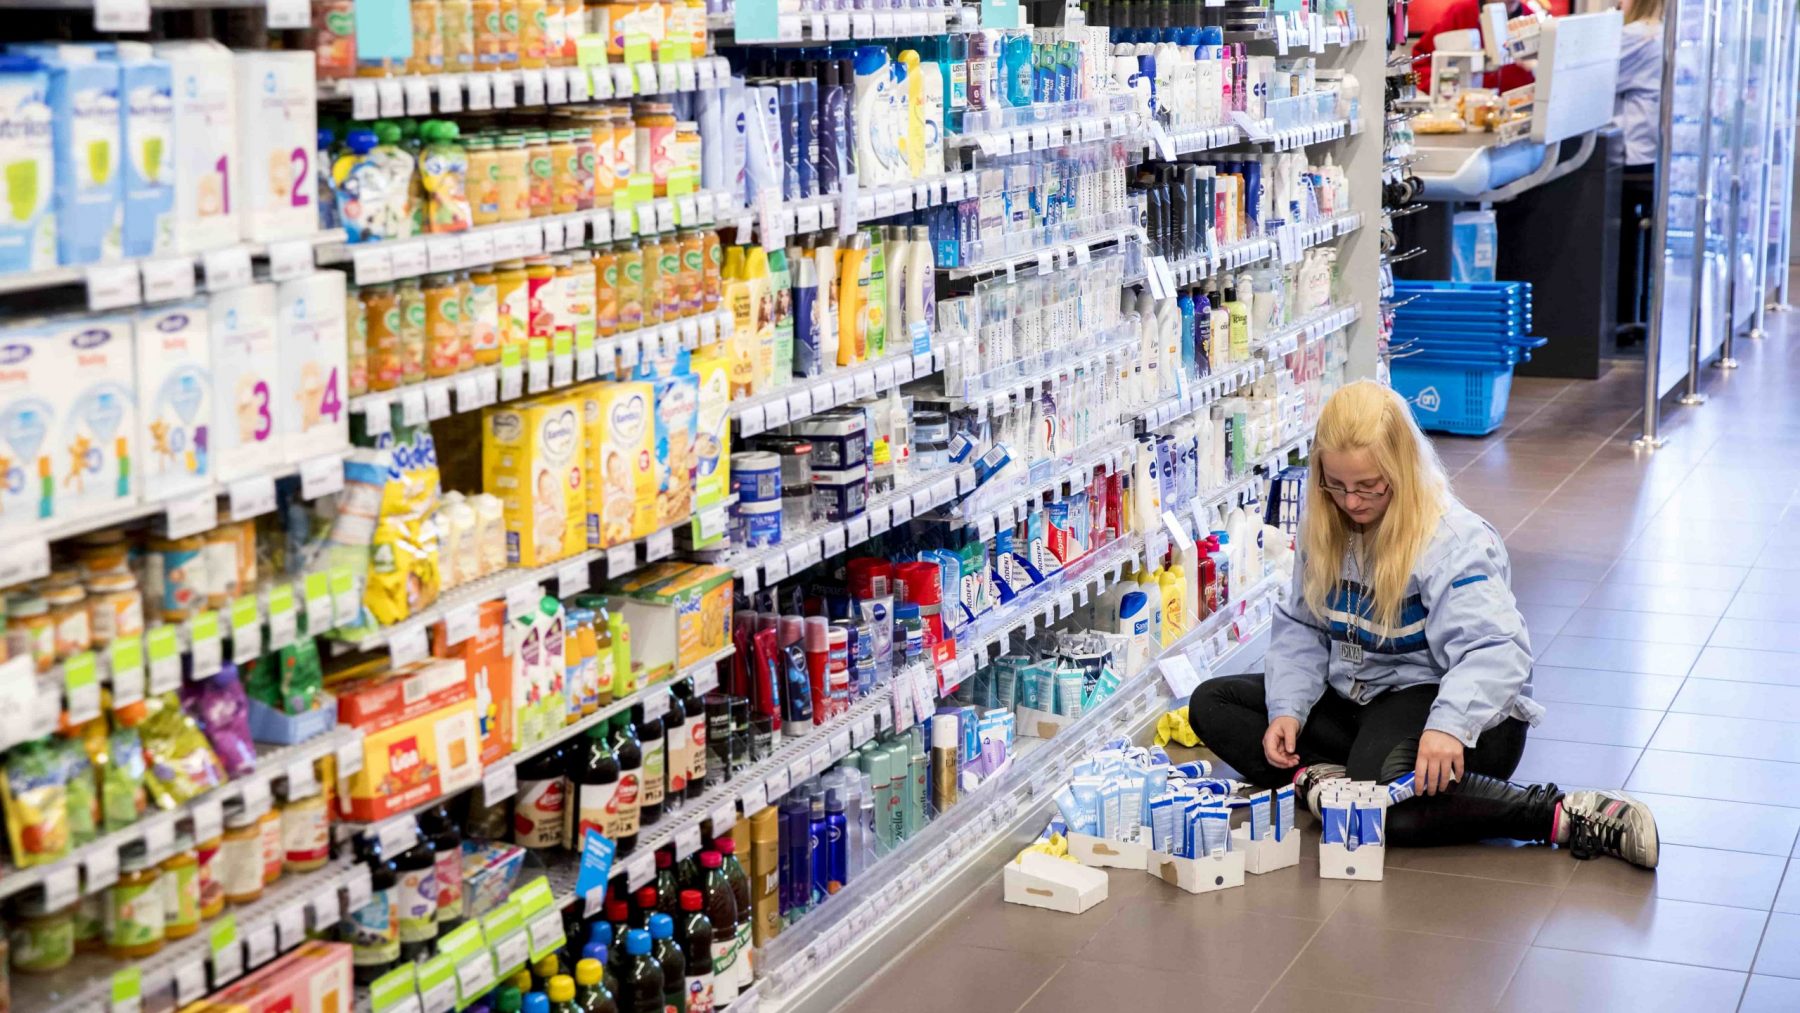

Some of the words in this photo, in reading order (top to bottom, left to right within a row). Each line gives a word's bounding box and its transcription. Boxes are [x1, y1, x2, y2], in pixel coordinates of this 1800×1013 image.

[216, 155, 229, 215] 1
[290, 147, 309, 207] 2
[254, 381, 272, 441] 3
[320, 366, 342, 423] 4
[1342, 644, 1361, 661] DIVA
